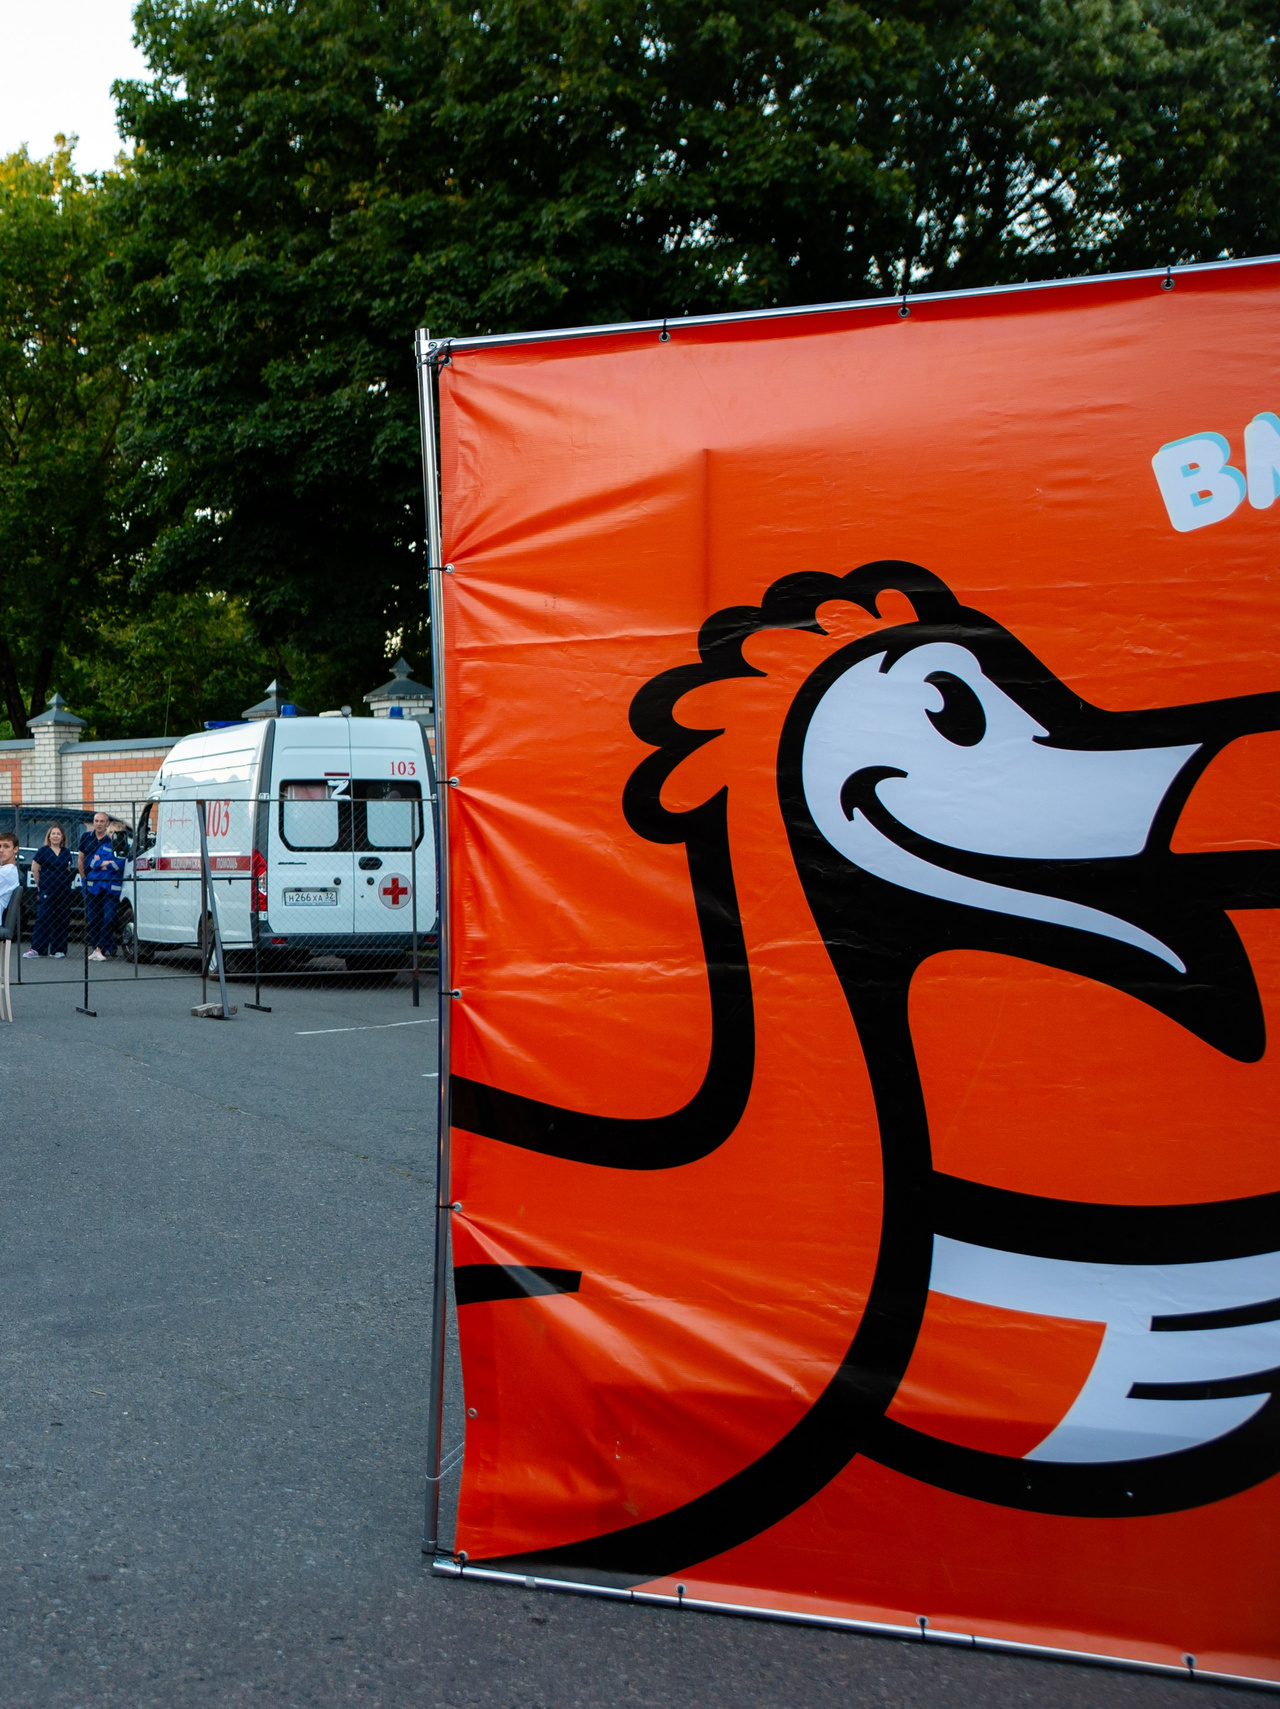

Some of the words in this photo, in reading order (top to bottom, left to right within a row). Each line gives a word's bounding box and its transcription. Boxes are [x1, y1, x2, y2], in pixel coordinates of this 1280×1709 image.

[390, 761, 416, 776] 103
[327, 779, 351, 800] Z
[205, 798, 231, 838] 103
[170, 857, 204, 871] МЕДИЦИНСКА
[325, 892, 334, 900] 32
